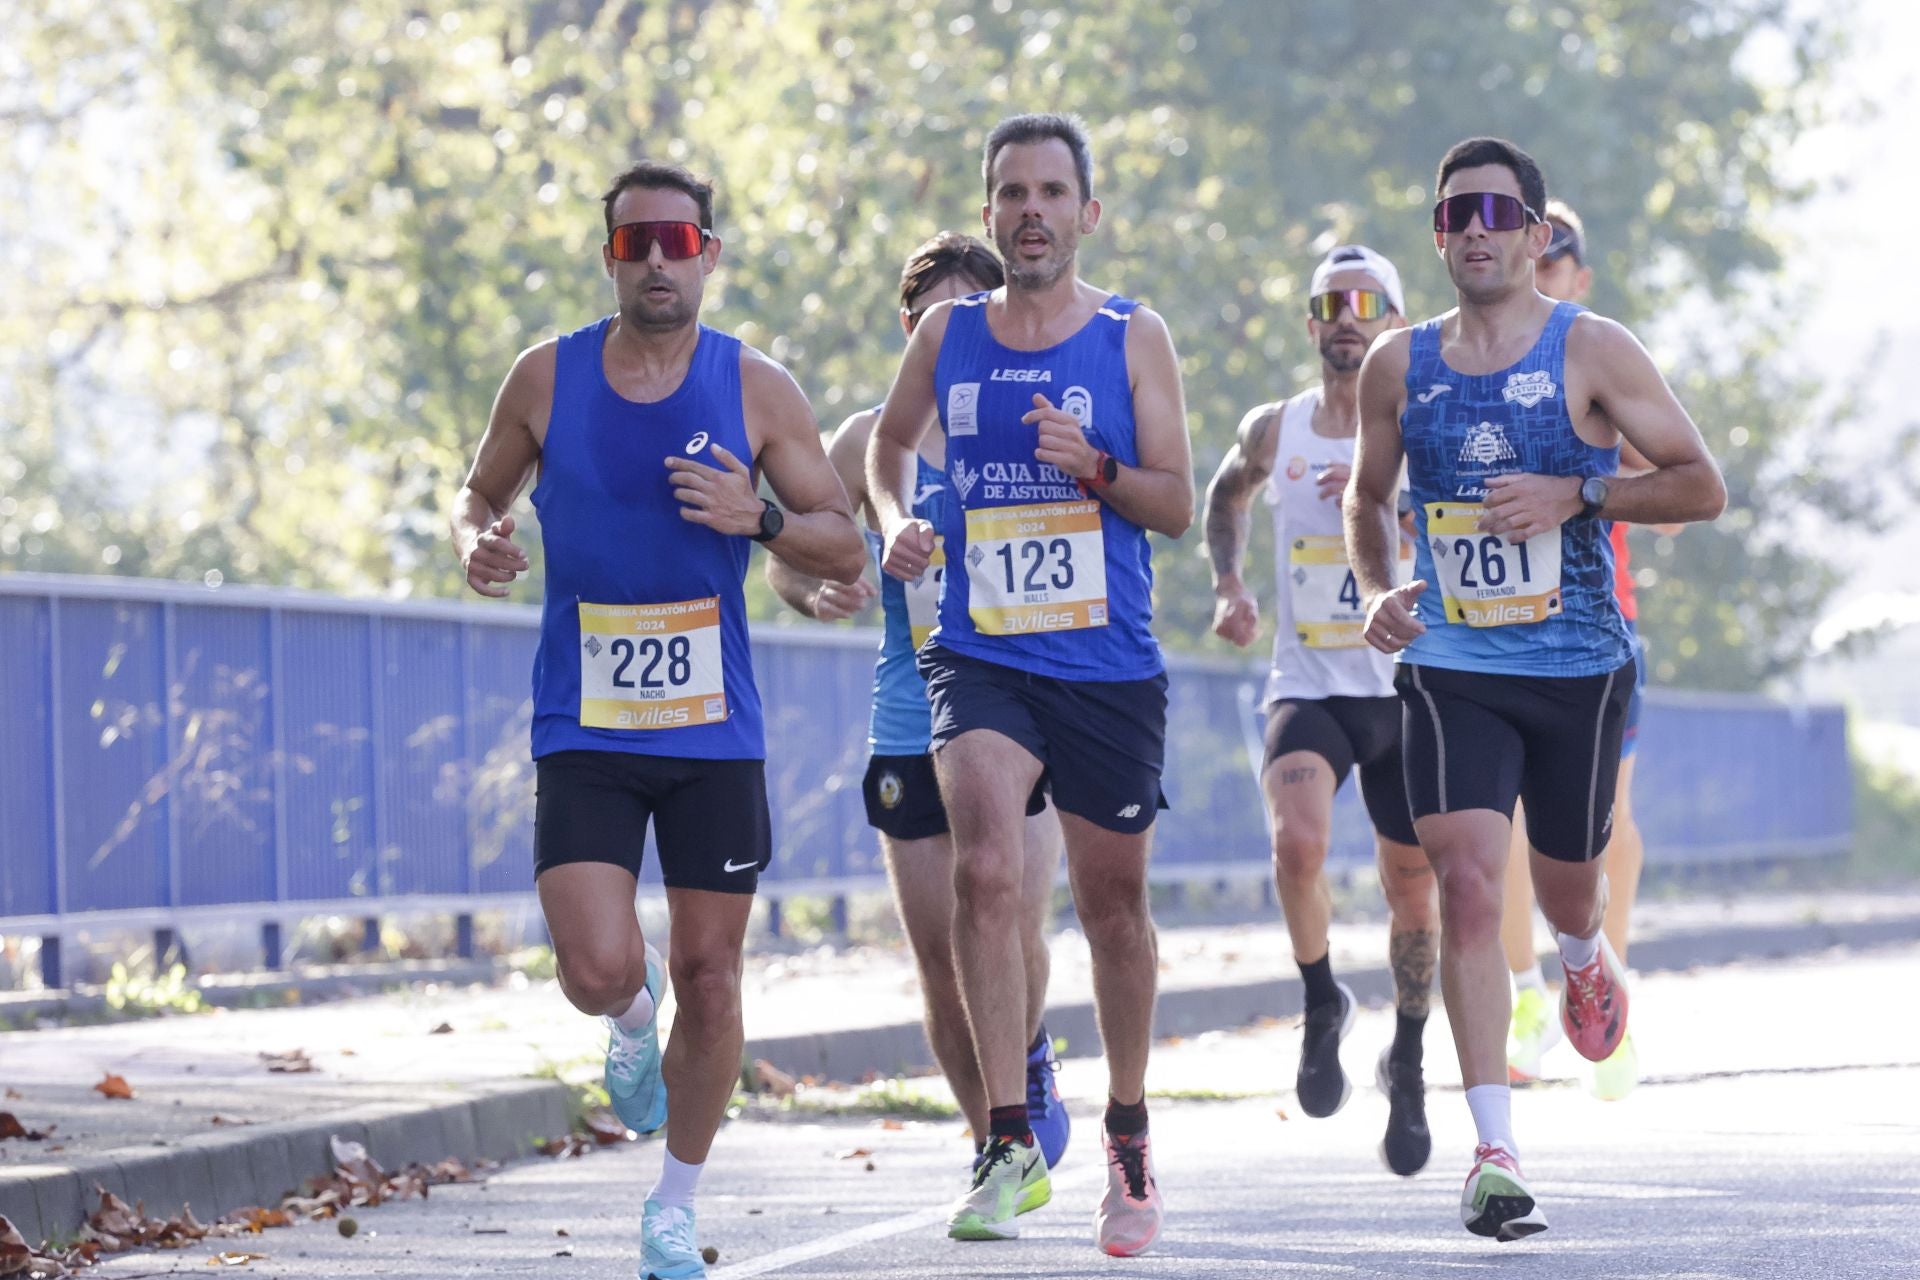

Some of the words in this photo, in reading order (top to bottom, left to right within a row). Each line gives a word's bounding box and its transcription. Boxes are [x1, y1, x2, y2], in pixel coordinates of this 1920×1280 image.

[990, 369, 1052, 382] LEGEA
[982, 463, 1034, 482] CAJA
[1037, 464, 1076, 483] RU
[984, 486, 1004, 499] DE
[1016, 522, 1046, 533] 2024
[996, 538, 1074, 593] 123
[1454, 536, 1531, 588] 261
[1023, 593, 1049, 603] WALLS
[1476, 586, 1516, 599] FERNANDO
[687, 599, 716, 613] AVILÉS
[635, 620, 666, 631] 2024
[610, 636, 691, 688] 228
[640, 690, 666, 699] NACHO
